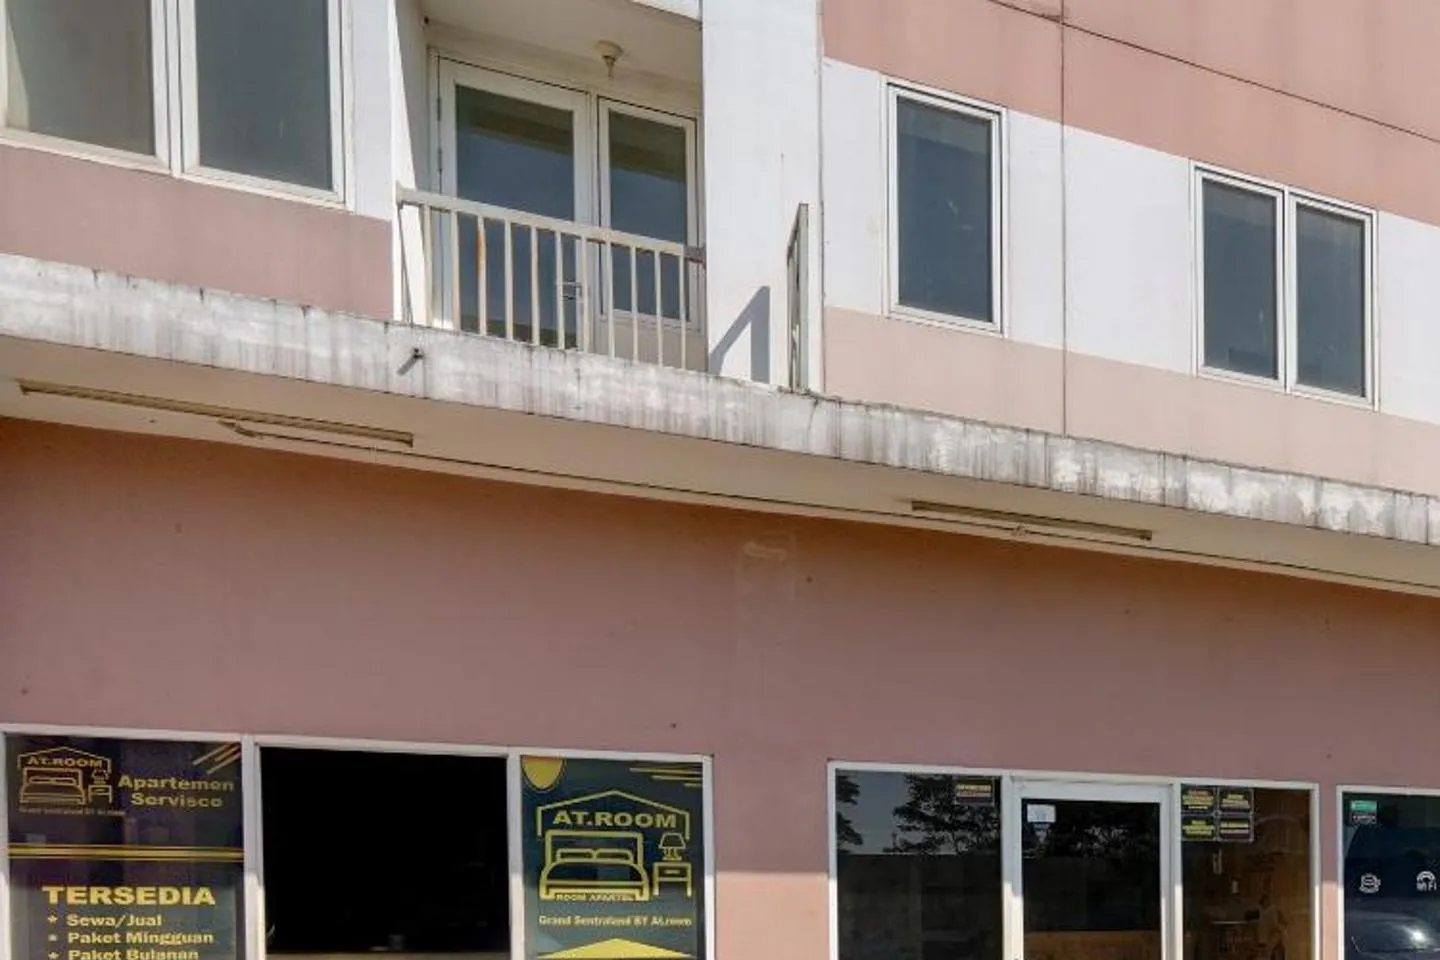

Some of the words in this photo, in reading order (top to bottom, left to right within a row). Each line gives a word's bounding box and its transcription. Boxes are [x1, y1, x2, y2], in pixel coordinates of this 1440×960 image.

[118, 775, 235, 791] Apartemen
[552, 810, 677, 828] AT.ROOM
[42, 885, 216, 905] TERSEDIA
[66, 914, 163, 927] Sewa/Jual
[67, 932, 121, 944] Paket
[126, 931, 214, 945] Mingguan
[68, 949, 121, 960] Paket
[126, 949, 199, 960] Bulanan
